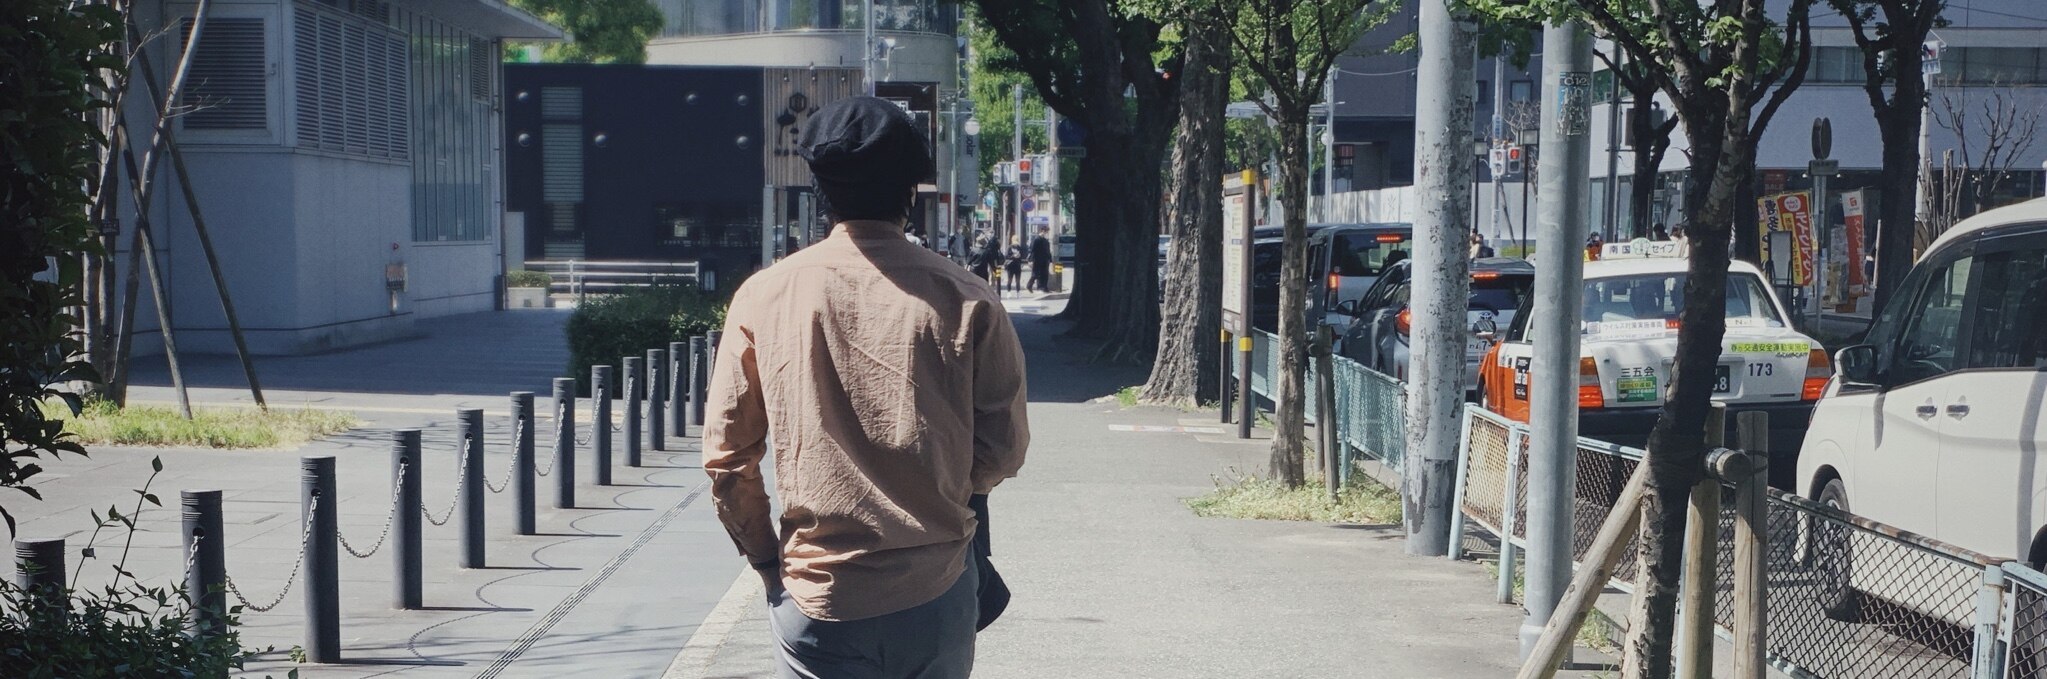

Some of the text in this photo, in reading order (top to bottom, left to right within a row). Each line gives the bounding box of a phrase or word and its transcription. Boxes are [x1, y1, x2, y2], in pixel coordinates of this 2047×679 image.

[1621, 366, 1655, 378] 三五会
[1748, 363, 1773, 376] 173
